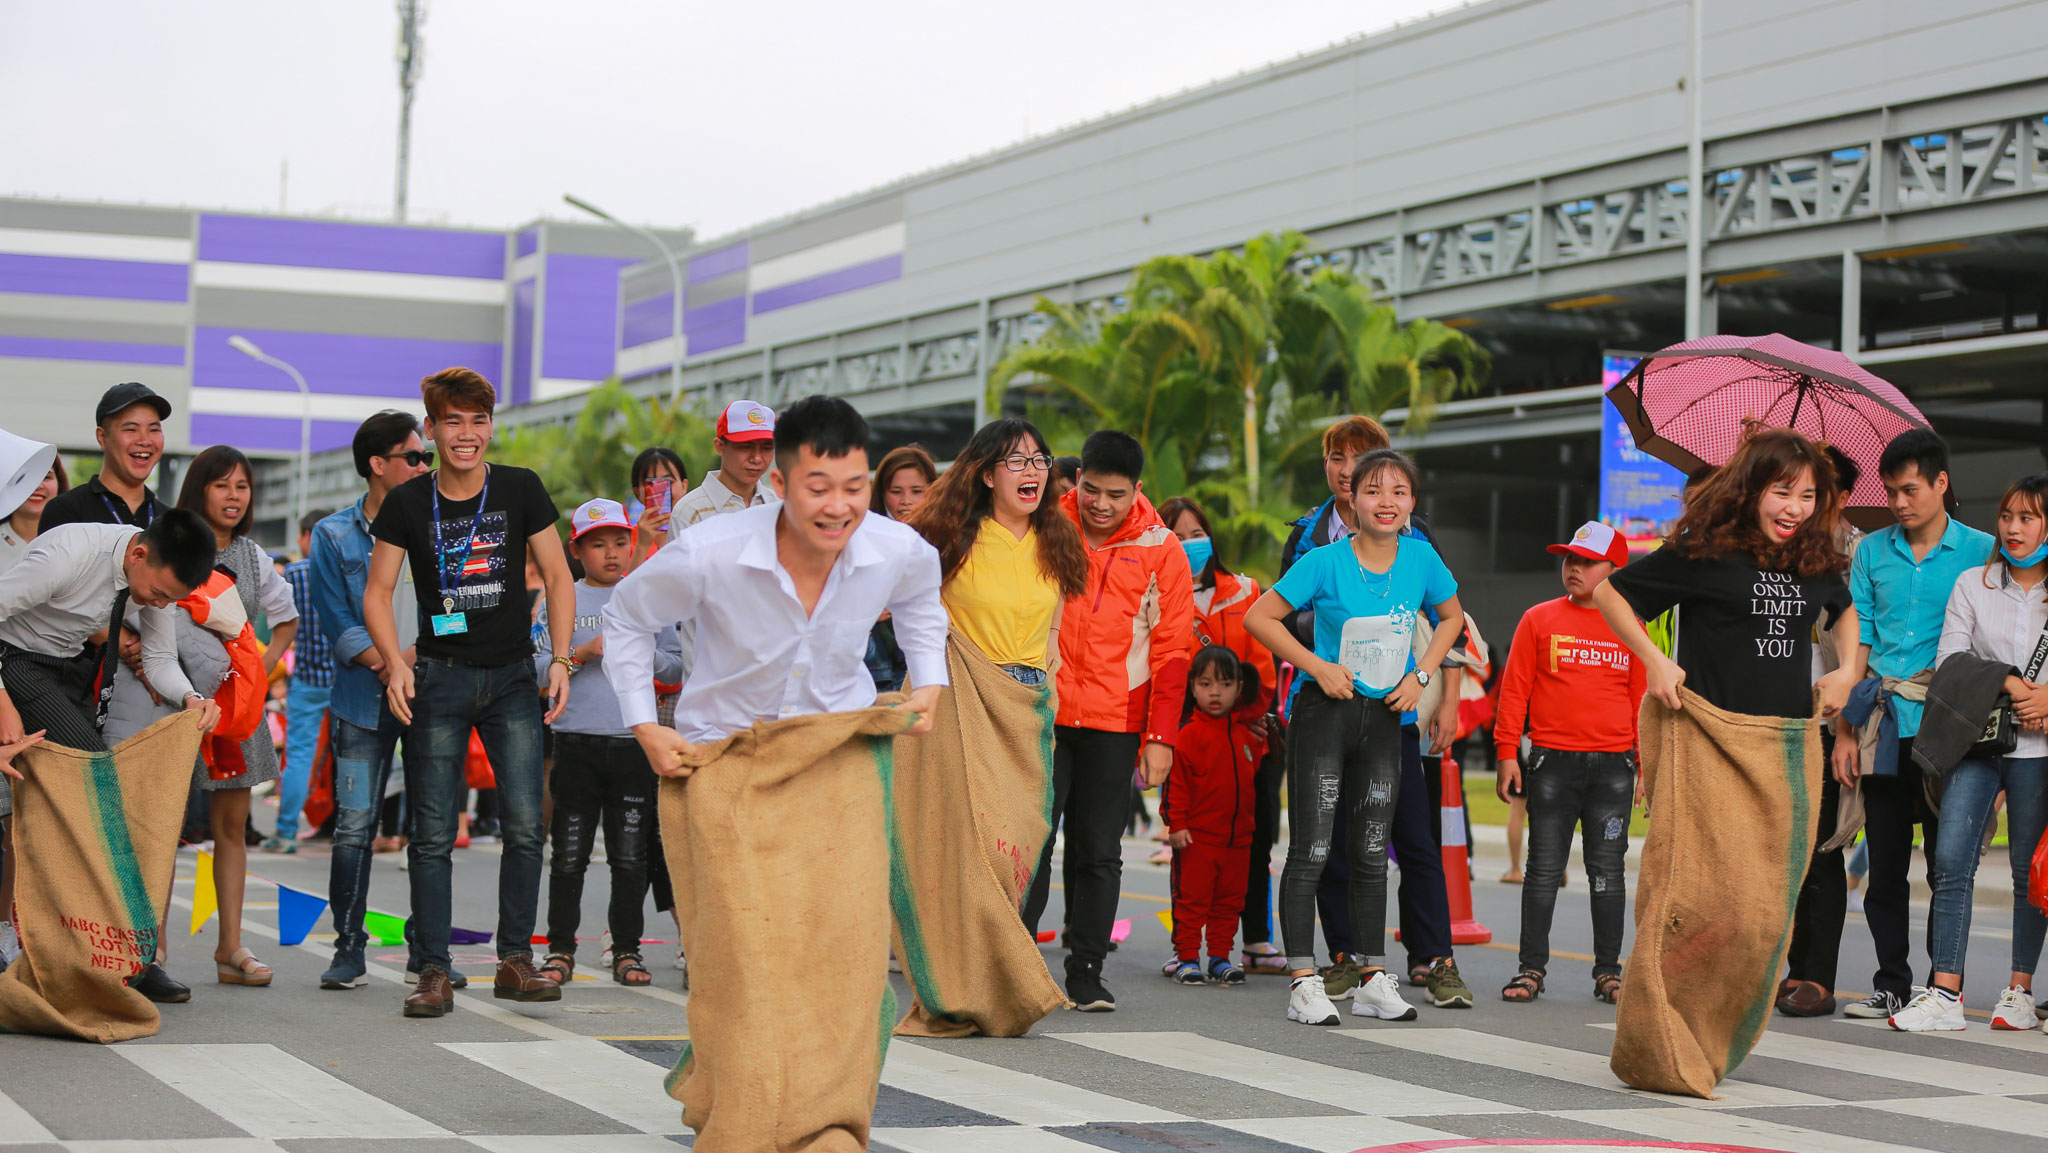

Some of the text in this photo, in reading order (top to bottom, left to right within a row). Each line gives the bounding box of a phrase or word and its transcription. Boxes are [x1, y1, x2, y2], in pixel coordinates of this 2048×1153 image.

[1758, 570, 1792, 583] YOU
[1753, 583, 1802, 598] ONLY
[1751, 598, 1807, 616] LIMIT
[1767, 618, 1786, 635] IS
[1755, 638, 1795, 658] YOU
[89, 935, 153, 957] LOT NO
[91, 953, 126, 972] NET
